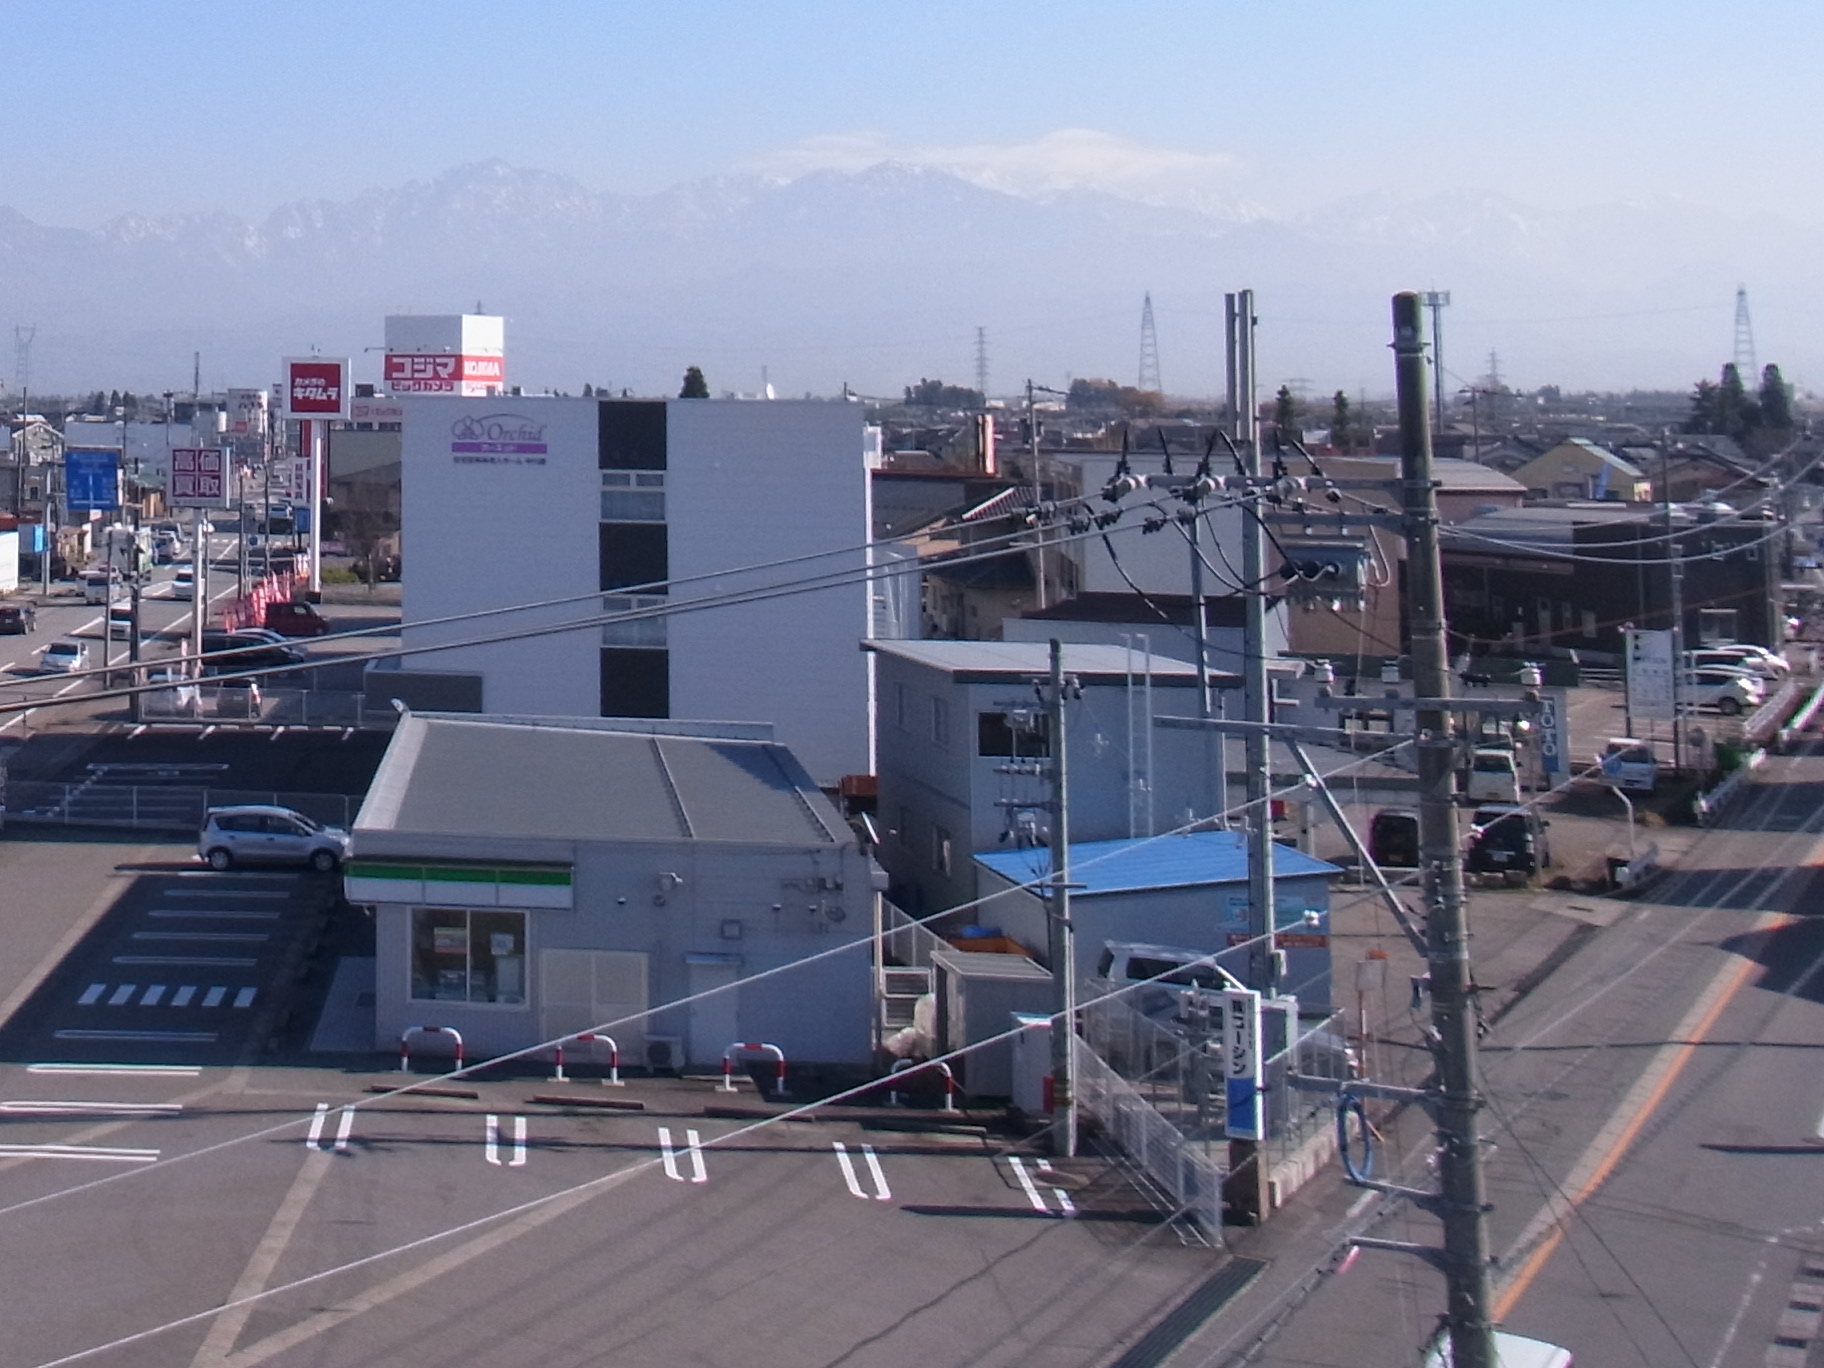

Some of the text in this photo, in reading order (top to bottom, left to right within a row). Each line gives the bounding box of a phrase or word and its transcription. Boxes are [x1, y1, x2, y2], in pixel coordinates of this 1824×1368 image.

[392, 357, 456, 379] コジマ
[293, 387, 339, 401] キタムラ
[487, 422, 548, 442] Orchid
[1540, 700, 1556, 756] TOTO
